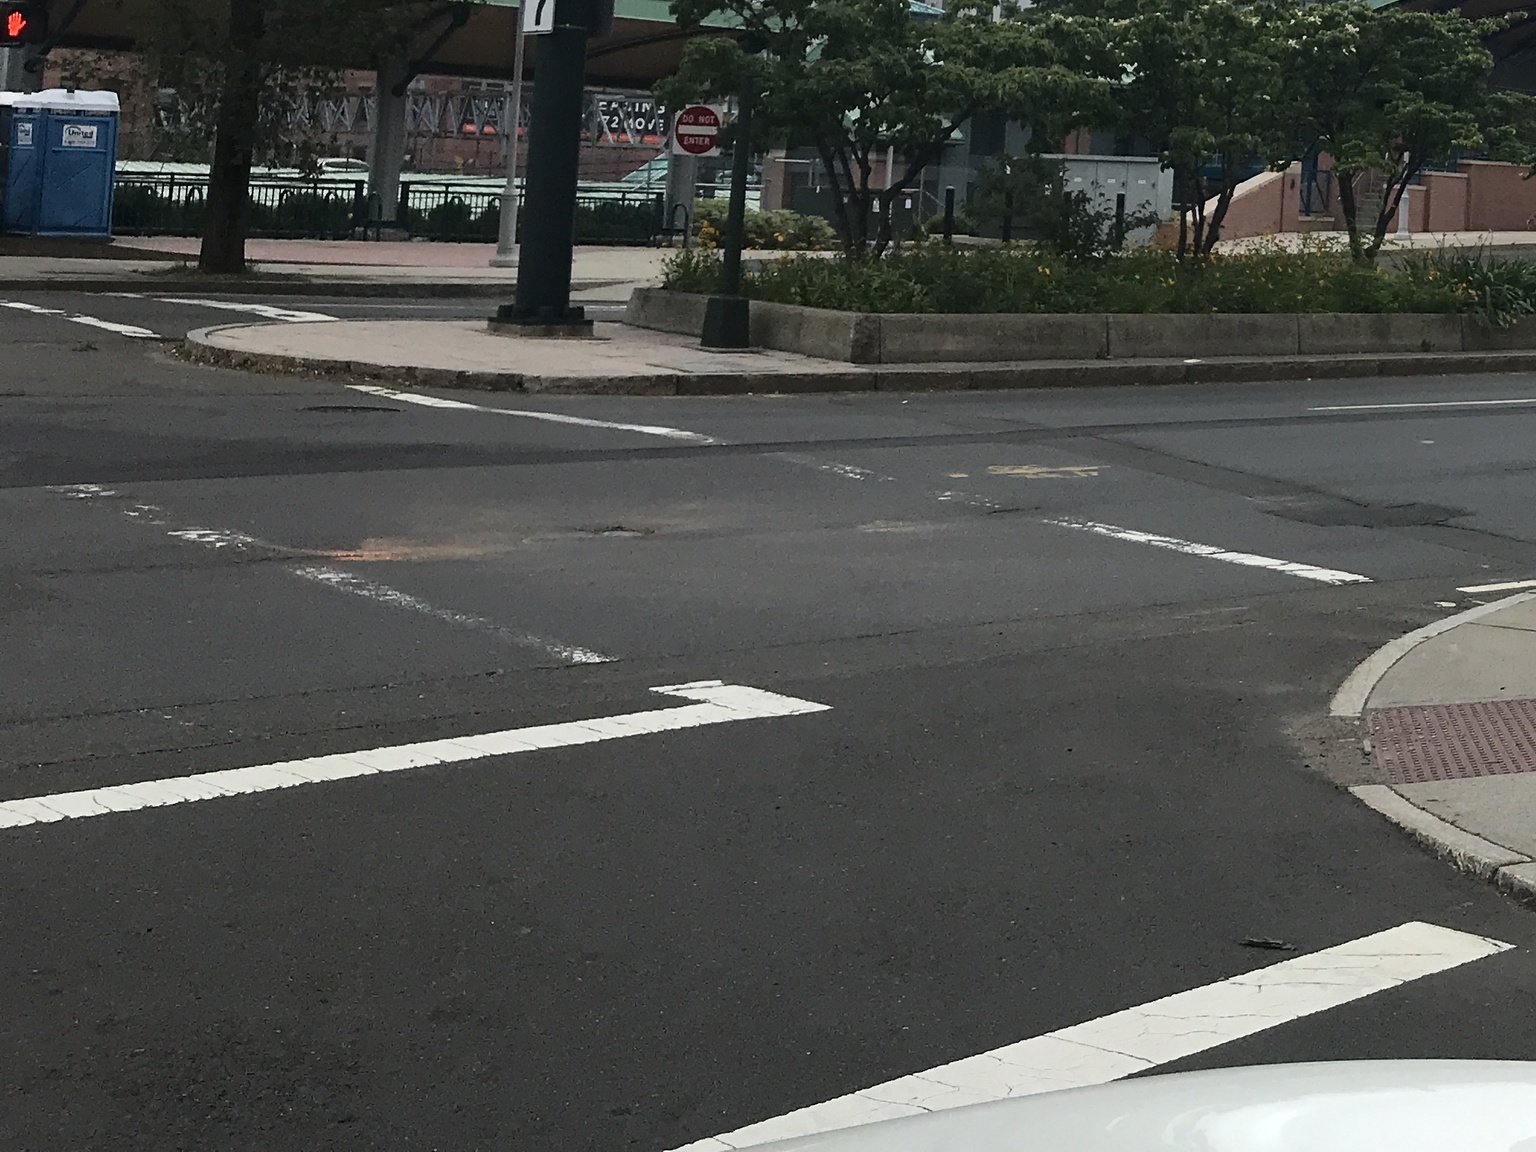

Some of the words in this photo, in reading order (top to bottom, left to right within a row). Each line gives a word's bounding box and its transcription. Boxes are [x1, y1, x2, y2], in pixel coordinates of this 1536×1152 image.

[682, 114, 694, 123] DO
[698, 115, 716, 124] NOT
[68, 128, 94, 136] United
[683, 136, 710, 145] ENTER
